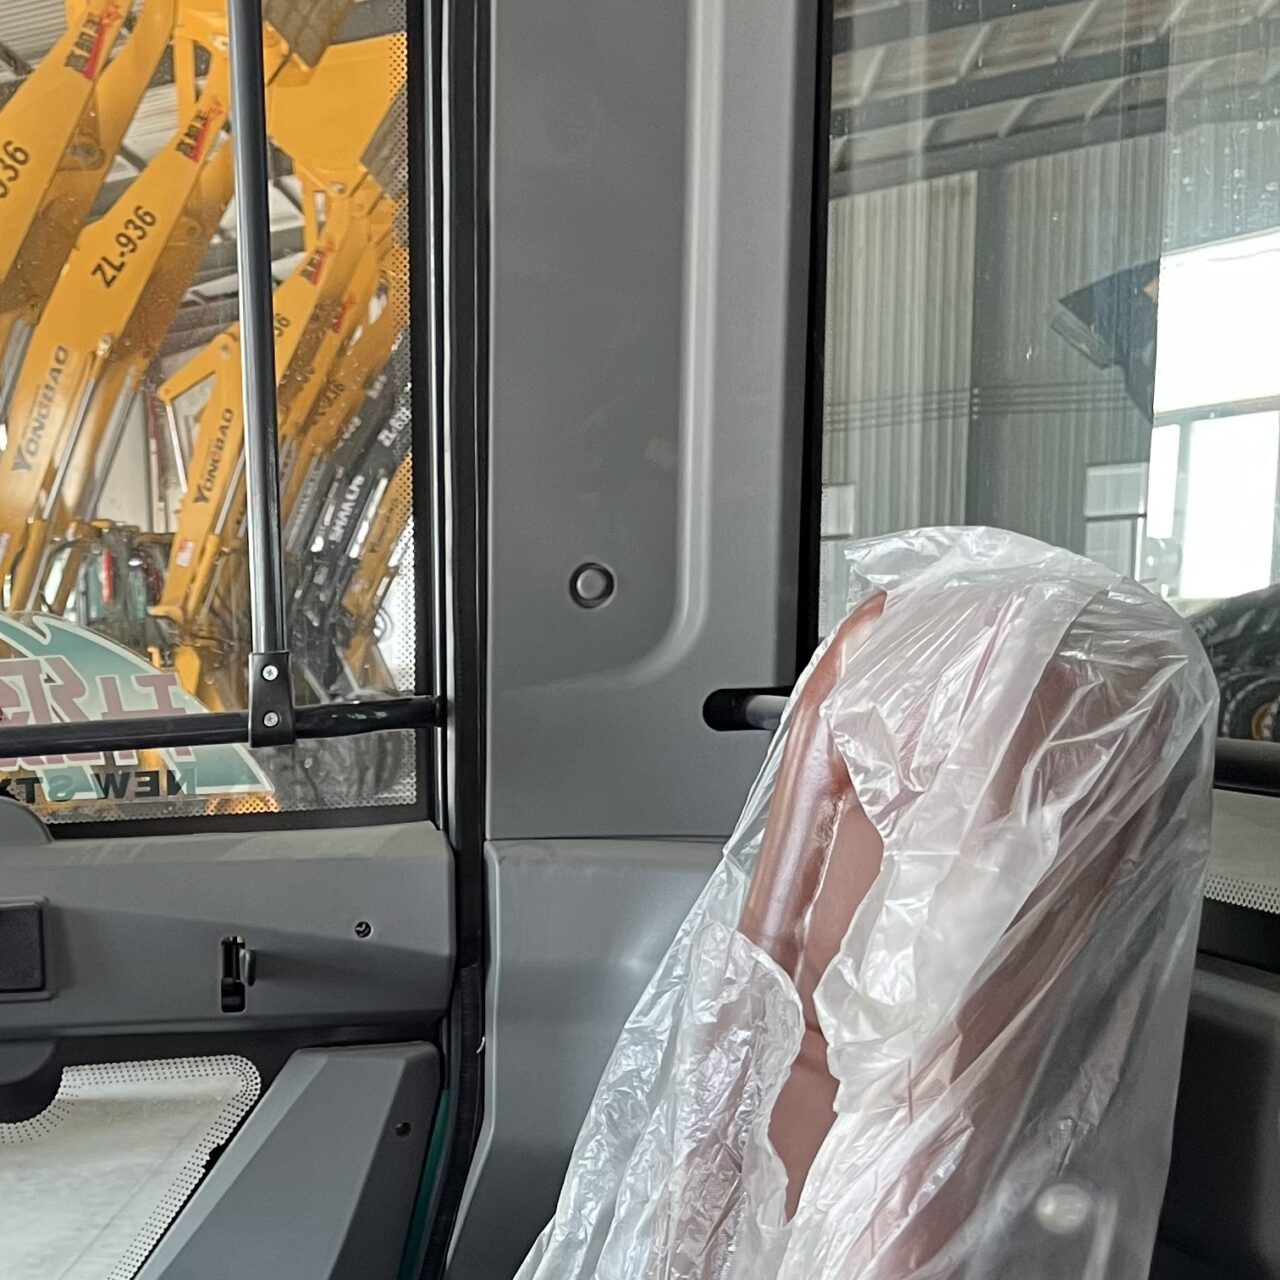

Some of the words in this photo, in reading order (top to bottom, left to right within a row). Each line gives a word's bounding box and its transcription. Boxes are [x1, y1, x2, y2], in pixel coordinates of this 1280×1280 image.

[90, 205, 158, 290] ZL-936
[10, 345, 71, 475] YONGBAO
[192, 407, 235, 507] YONGBAO
